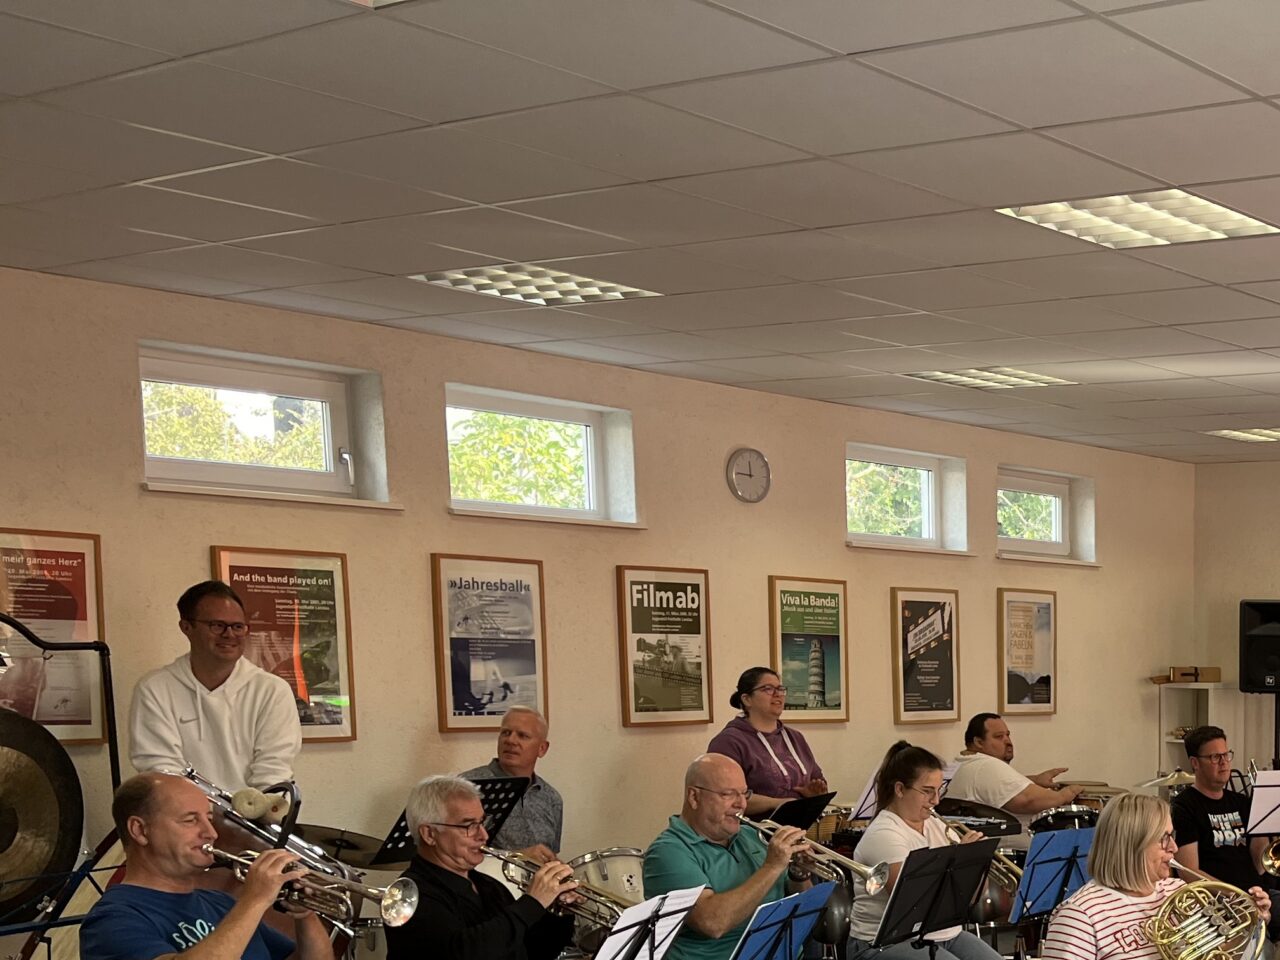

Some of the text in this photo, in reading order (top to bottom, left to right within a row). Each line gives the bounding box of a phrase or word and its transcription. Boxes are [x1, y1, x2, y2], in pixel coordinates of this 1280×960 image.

[26, 556, 56, 566] ganzes
[233, 572, 332, 586] And the band played on!
[631, 583, 699, 609] Film ab
[781, 593, 838, 608] Viva la Banda!
[1010, 640, 1033, 650] FABELN
[1208, 811, 1242, 829] FUTURE
